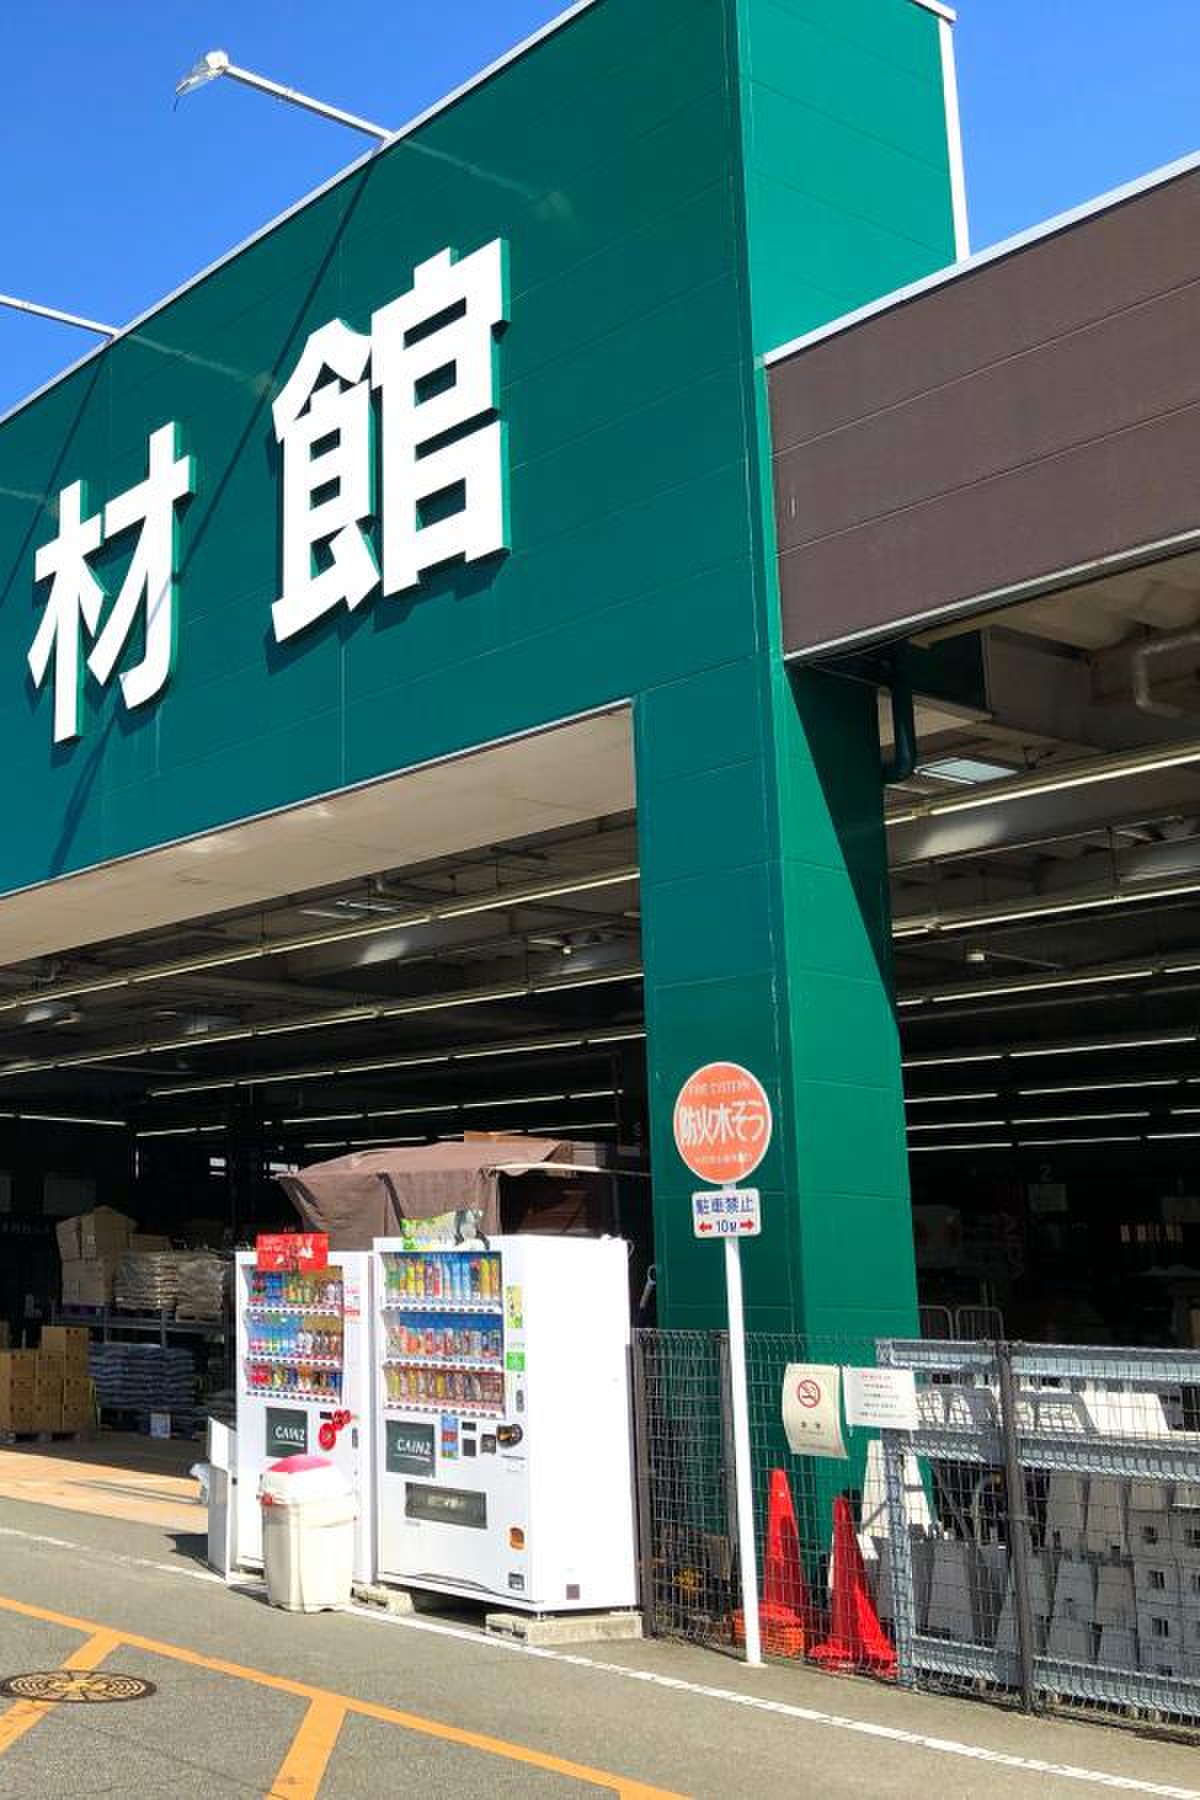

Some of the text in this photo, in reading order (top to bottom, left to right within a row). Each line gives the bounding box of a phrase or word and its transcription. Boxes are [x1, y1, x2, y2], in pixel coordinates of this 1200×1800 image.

[696, 1197, 754, 1216] 駐車禁止
[397, 1439, 432, 1455] CAINZ
